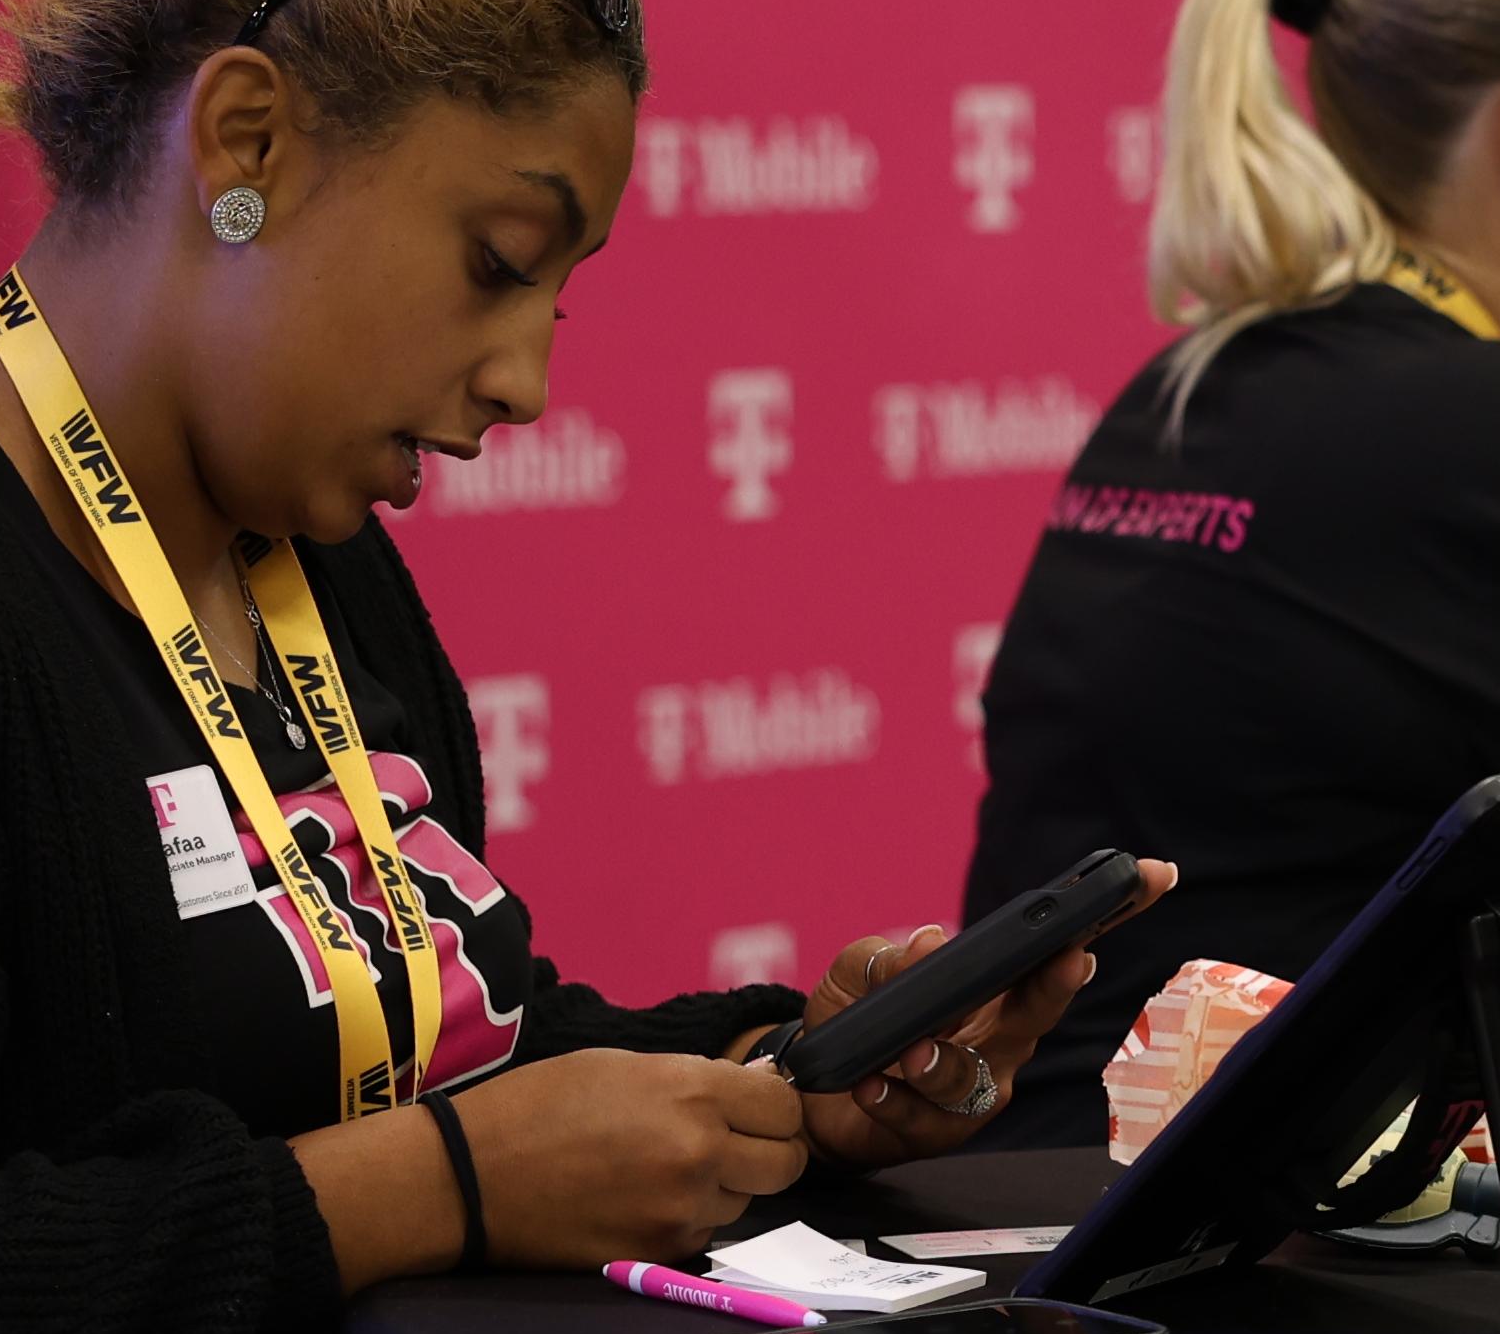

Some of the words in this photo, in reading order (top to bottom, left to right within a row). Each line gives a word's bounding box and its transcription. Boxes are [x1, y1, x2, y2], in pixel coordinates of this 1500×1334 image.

[694, 115, 878, 216] Mobile
[49, 433, 73, 470] VETERANS
[67, 468, 79, 479] OF
[73, 478, 94, 509] FOREIGN
[698, 670, 879, 777] Mobile
[164, 834, 206, 858] afaa
[168, 857, 195, 873] ociate
[196, 849, 237, 866] Manager
[213, 888, 233, 902] Since
[662, 1282, 718, 1310] Mobile
